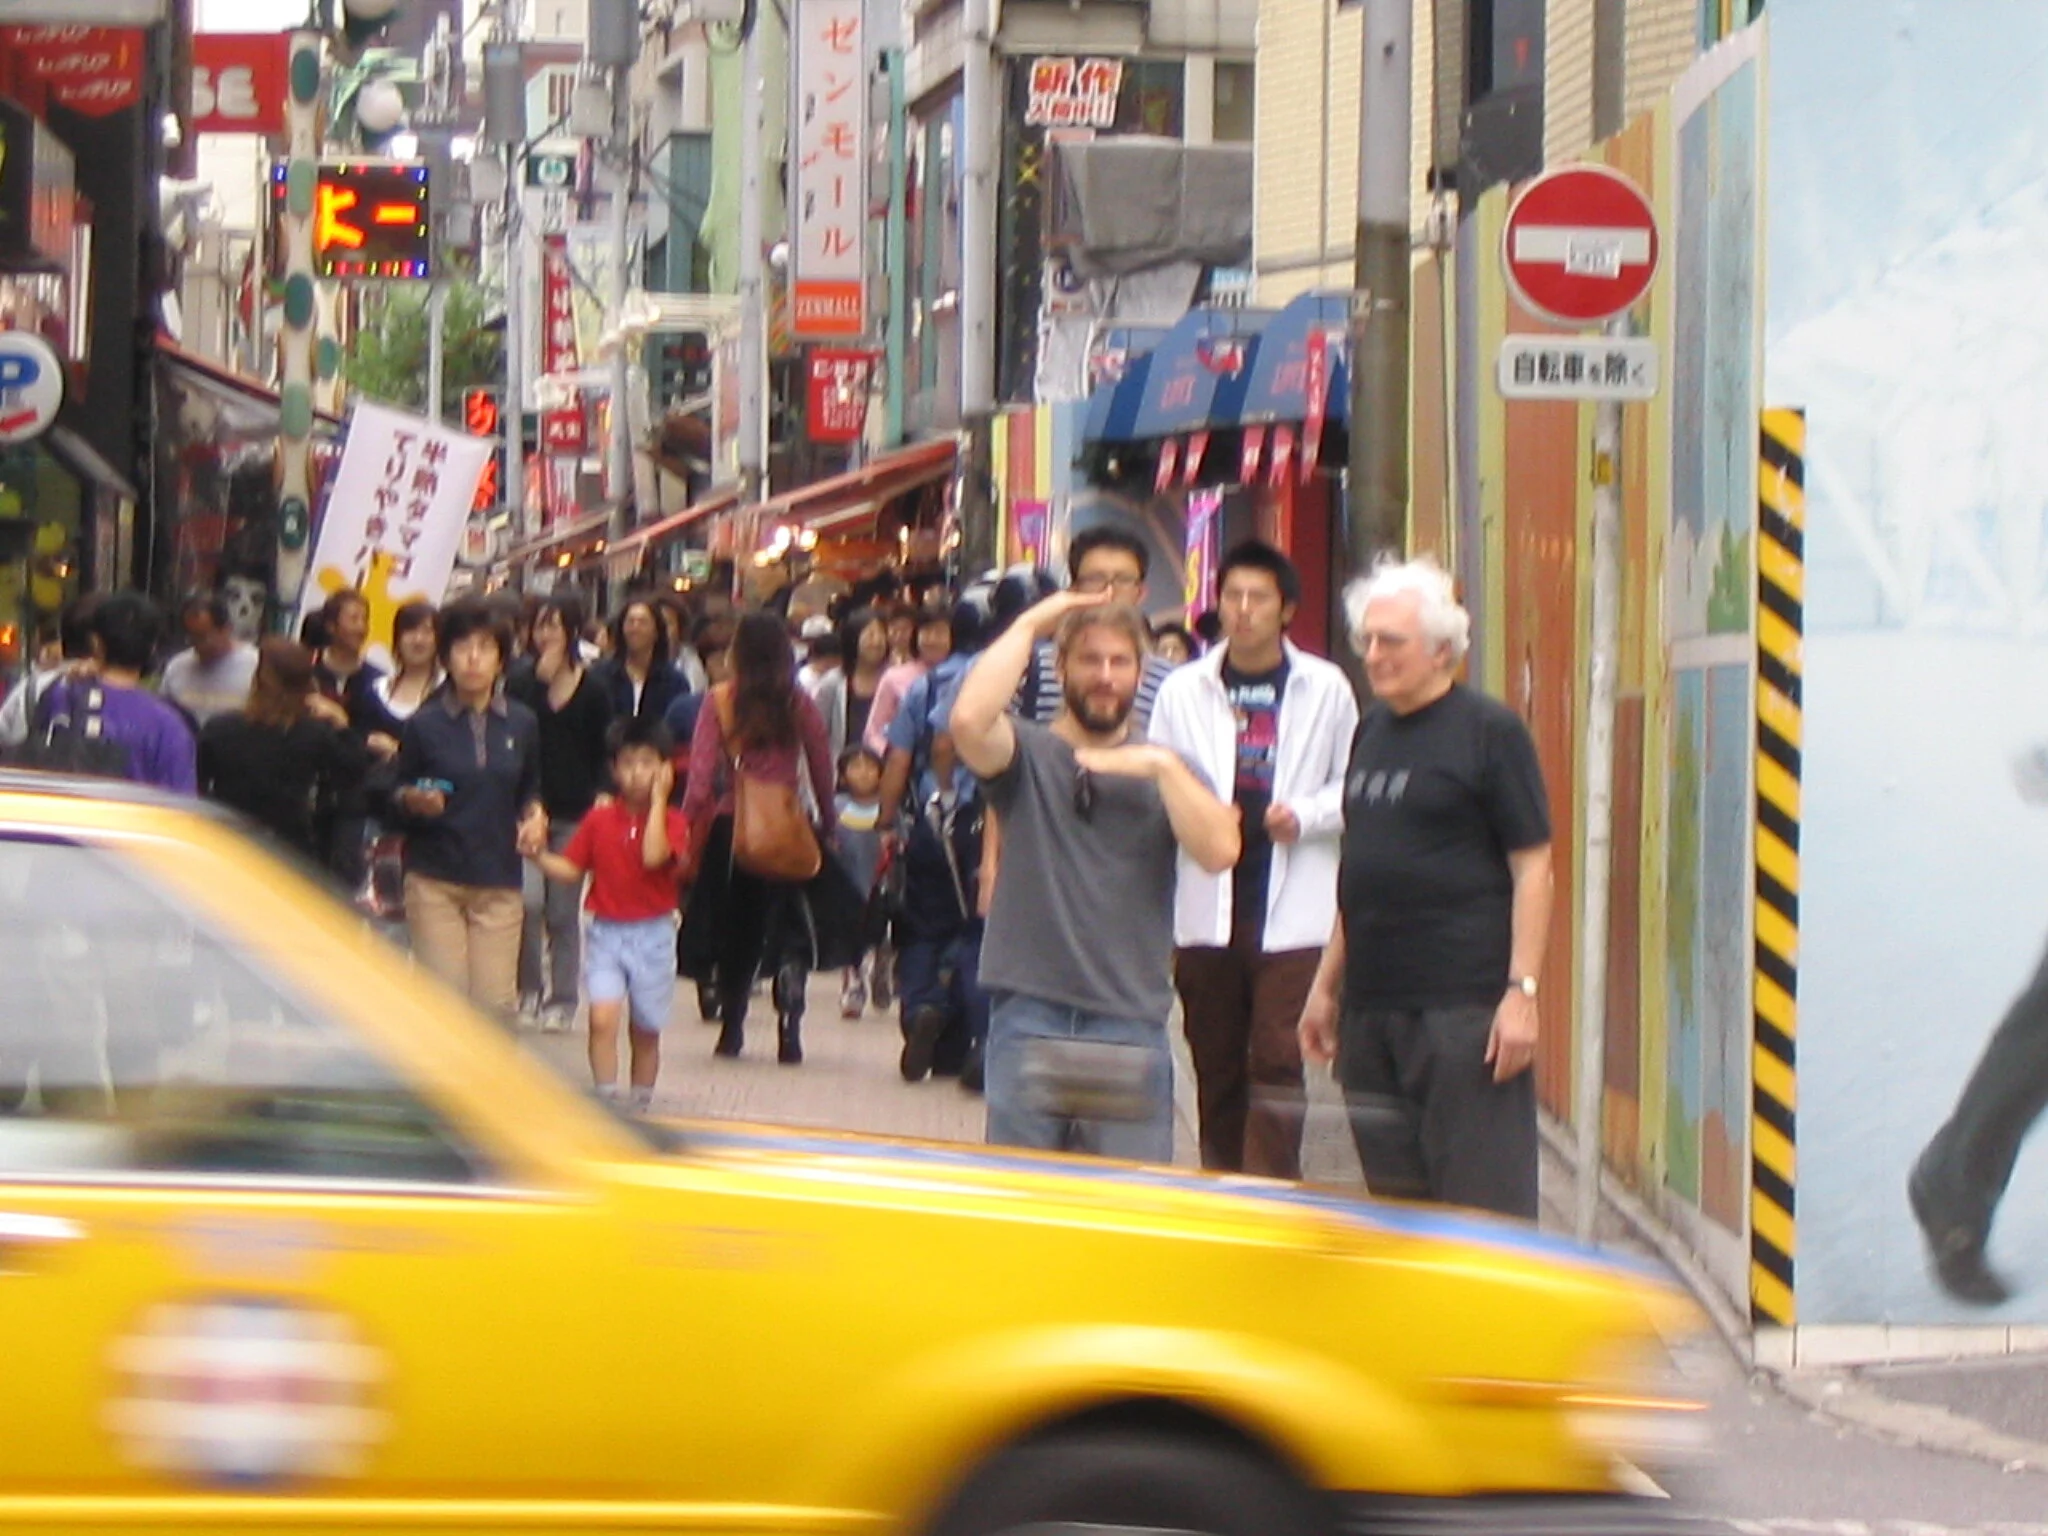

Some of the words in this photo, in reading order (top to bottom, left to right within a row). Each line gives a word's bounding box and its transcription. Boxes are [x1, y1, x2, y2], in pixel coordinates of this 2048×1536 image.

[1514, 350, 1645, 386] 自転車を除く
